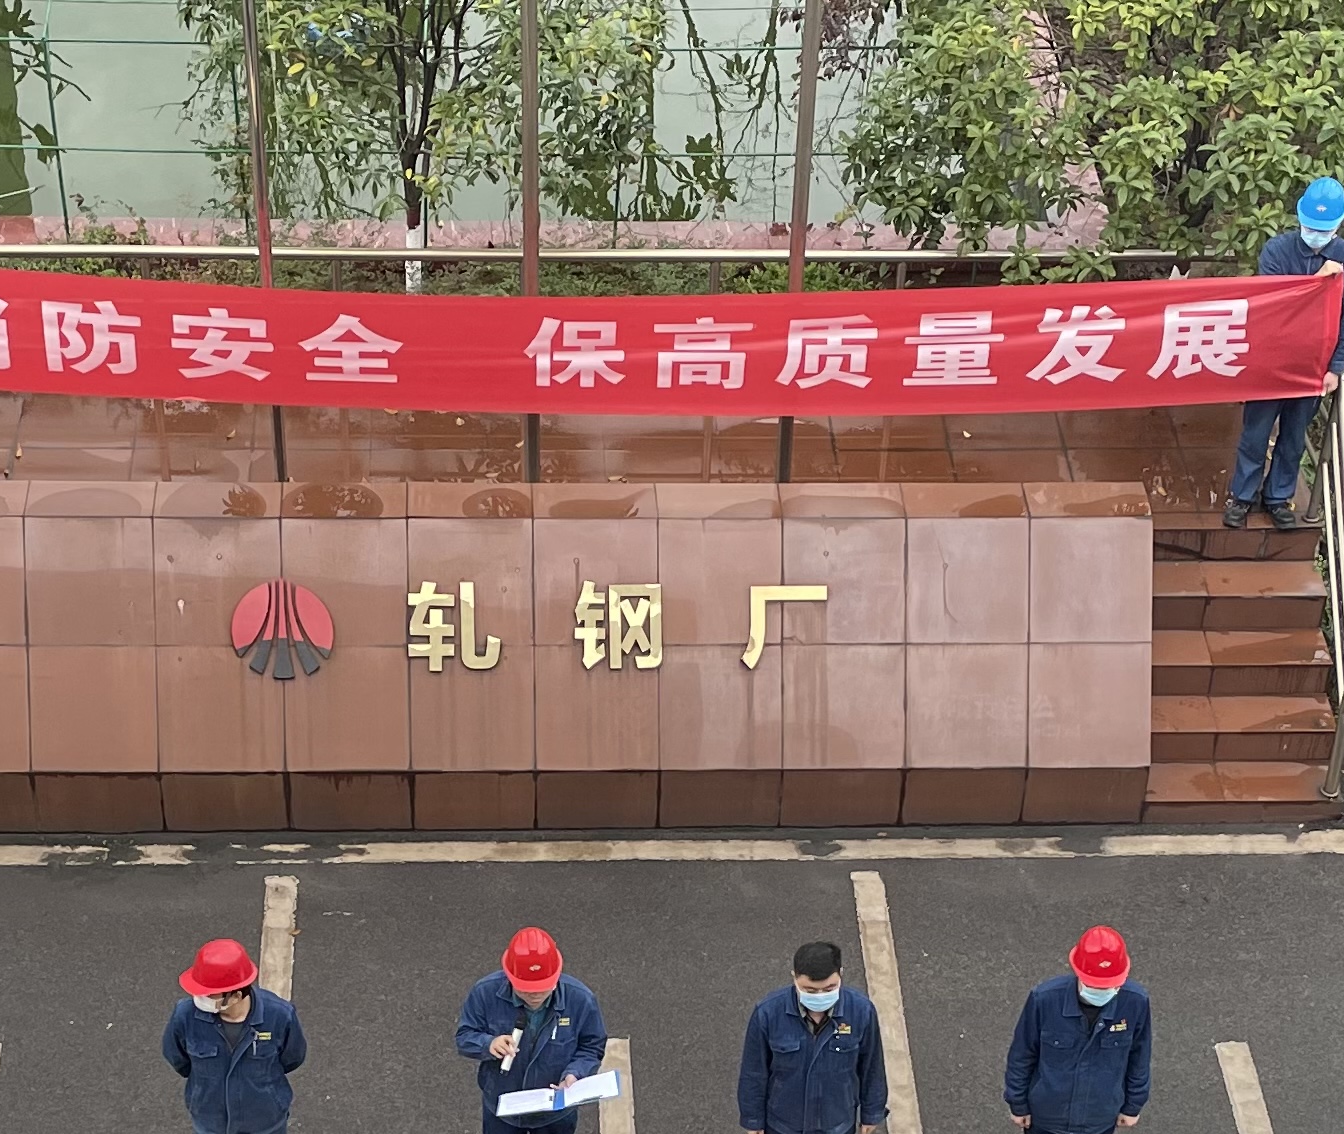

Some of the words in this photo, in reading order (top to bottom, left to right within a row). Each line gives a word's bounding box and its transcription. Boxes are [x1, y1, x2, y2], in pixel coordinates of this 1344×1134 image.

[523, 297, 1251, 389] 保高质量发展
[406, 580, 829, 672] 轧钢厂
